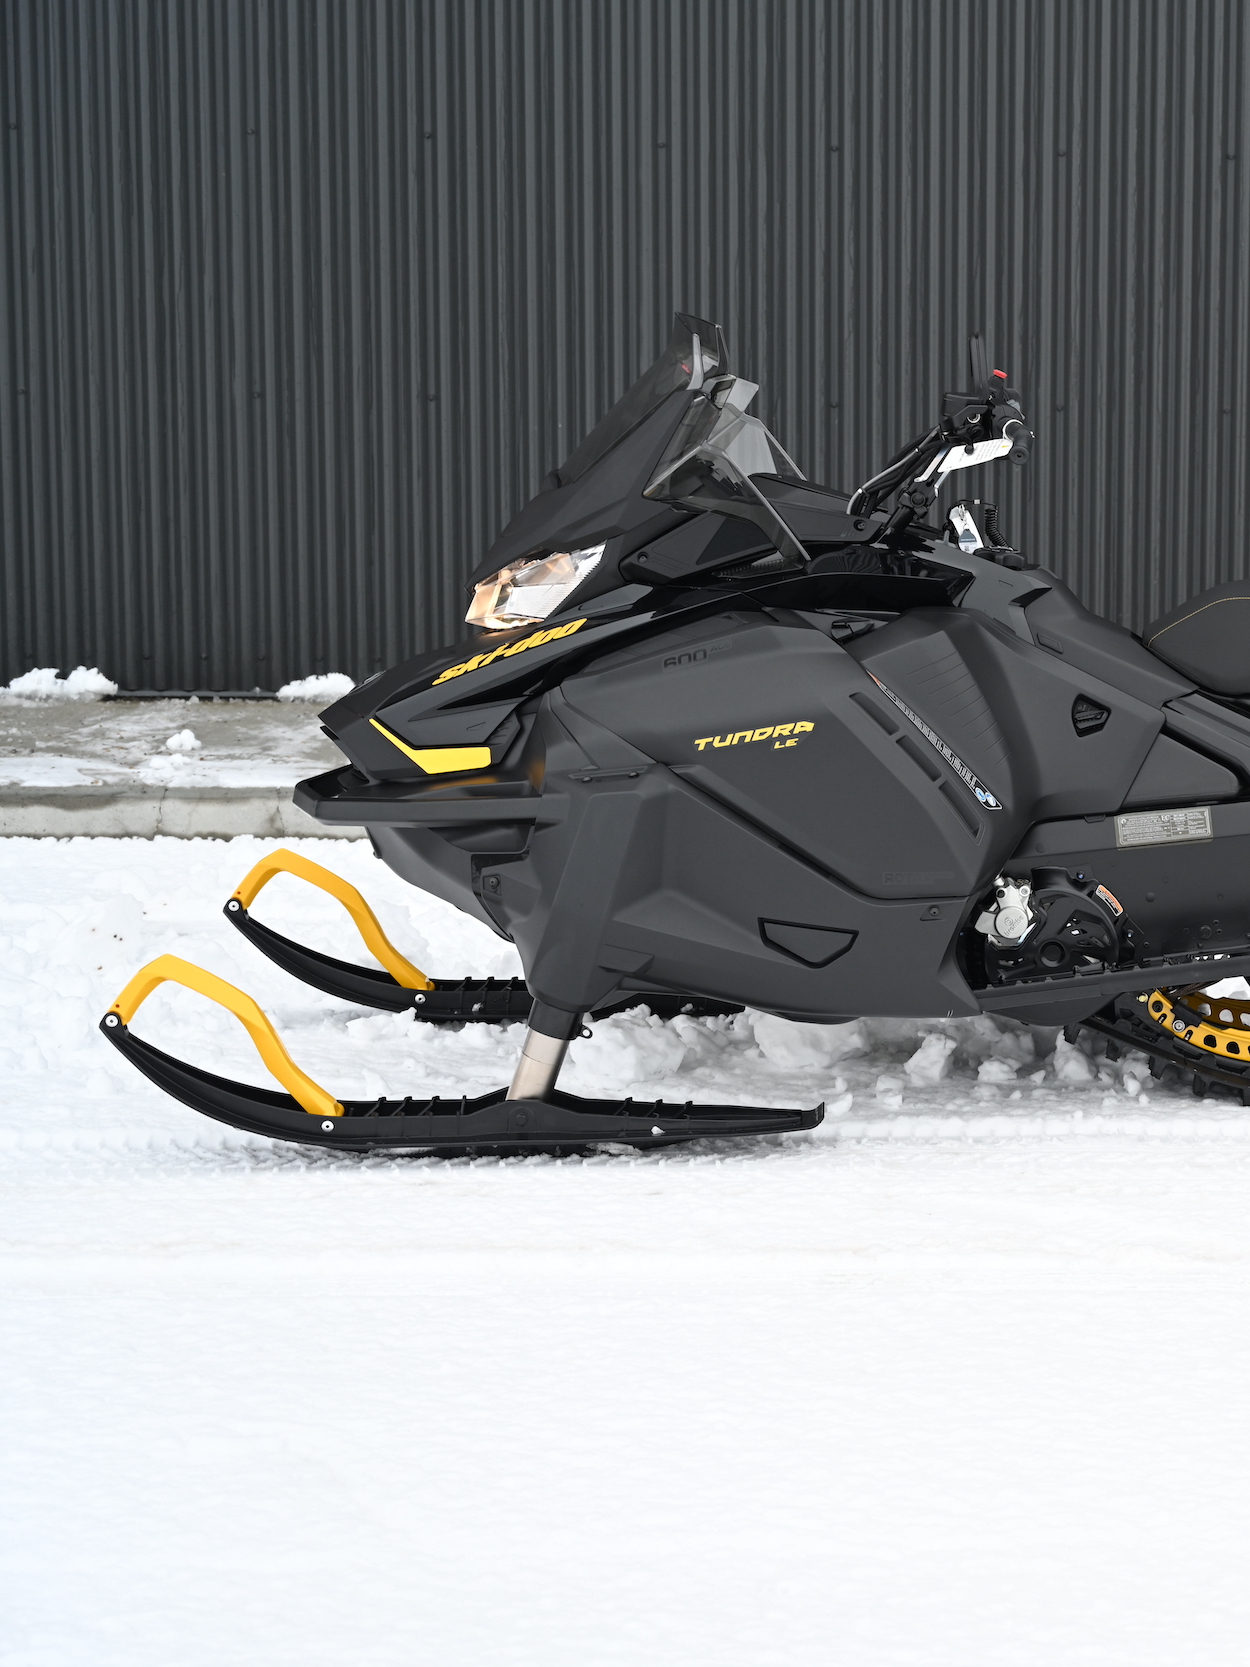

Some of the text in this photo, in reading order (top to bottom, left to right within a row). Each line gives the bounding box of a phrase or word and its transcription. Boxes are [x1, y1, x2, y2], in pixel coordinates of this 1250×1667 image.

[663, 648, 708, 671] 600
[694, 721, 815, 751] TUNDRA
[774, 738, 799, 749] LE
[884, 872, 934, 884] ROT
[1003, 915, 1025, 937] brembo
